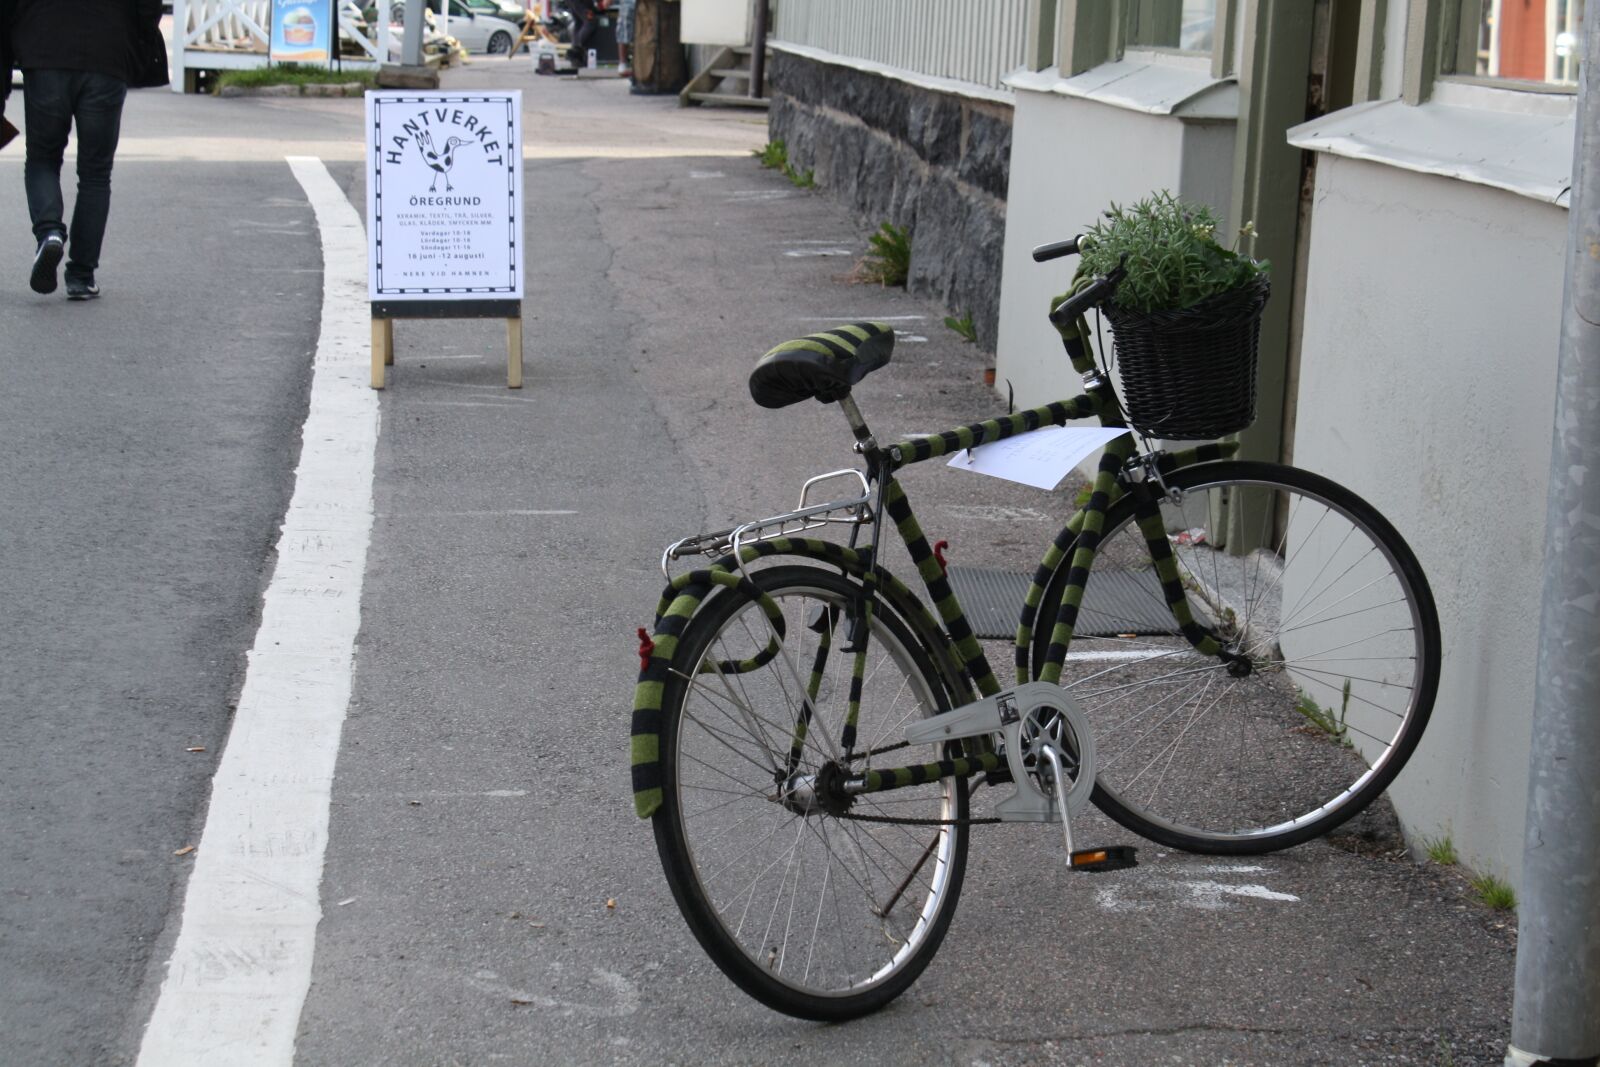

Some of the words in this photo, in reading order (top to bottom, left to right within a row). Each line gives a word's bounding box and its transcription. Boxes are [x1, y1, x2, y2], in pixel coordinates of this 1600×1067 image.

[386, 108, 503, 166] HANTVERKET
[409, 195, 481, 206] ÖREGRUND
[419, 253, 436, 261] juni
[454, 252, 485, 261] augusti
